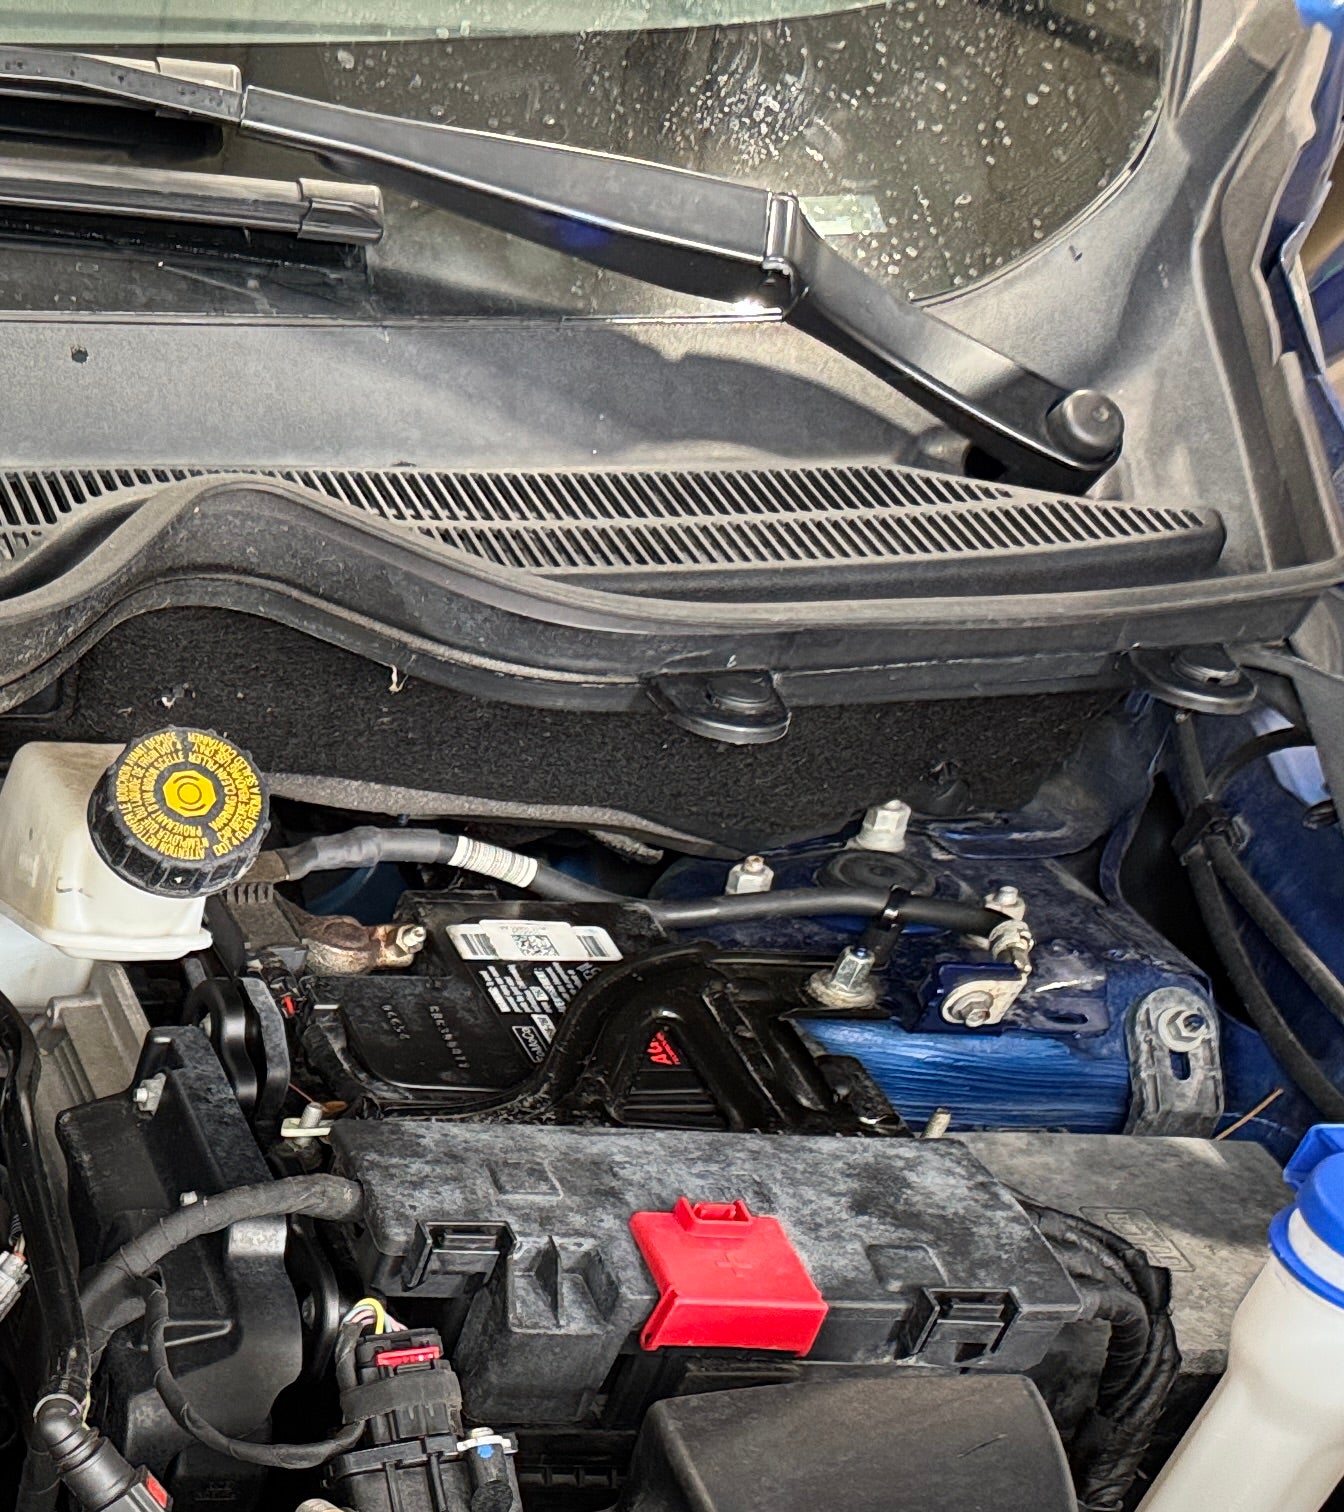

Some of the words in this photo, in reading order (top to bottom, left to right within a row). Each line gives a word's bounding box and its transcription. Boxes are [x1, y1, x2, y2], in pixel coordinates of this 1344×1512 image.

[126, 744, 148, 766] AVANT
[155, 740, 175, 755] DOT
[188, 733, 237, 759] CONTAINER
[192, 742, 215, 757] ONLY
[137, 748, 160, 768] FREIN
[188, 752, 219, 771] FILLER
[212, 750, 231, 767] USE
[131, 765, 146, 778] DE
[142, 766, 160, 791] BIDON
[214, 767, 237, 795] CLEAN
[234, 756, 258, 787] SEALED
[116, 765, 132, 802] BOUCHON
[128, 776, 142, 807] LIQUIDE
[120, 802, 132, 813] LE
[132, 806, 147, 820] DU
[209, 796, 237, 831] WARNING
[229, 802, 250, 831] BEFORE
[247, 795, 261, 820] FROM
[124, 812, 160, 848] NETTOYER
[140, 816, 159, 834] QUE
[151, 810, 203, 837] PROVENANT
[217, 826, 234, 843] CAP
[235, 817, 256, 841] FLUID
[158, 841, 205, 860] ATTENTION
[213, 839, 232, 856] DOT
